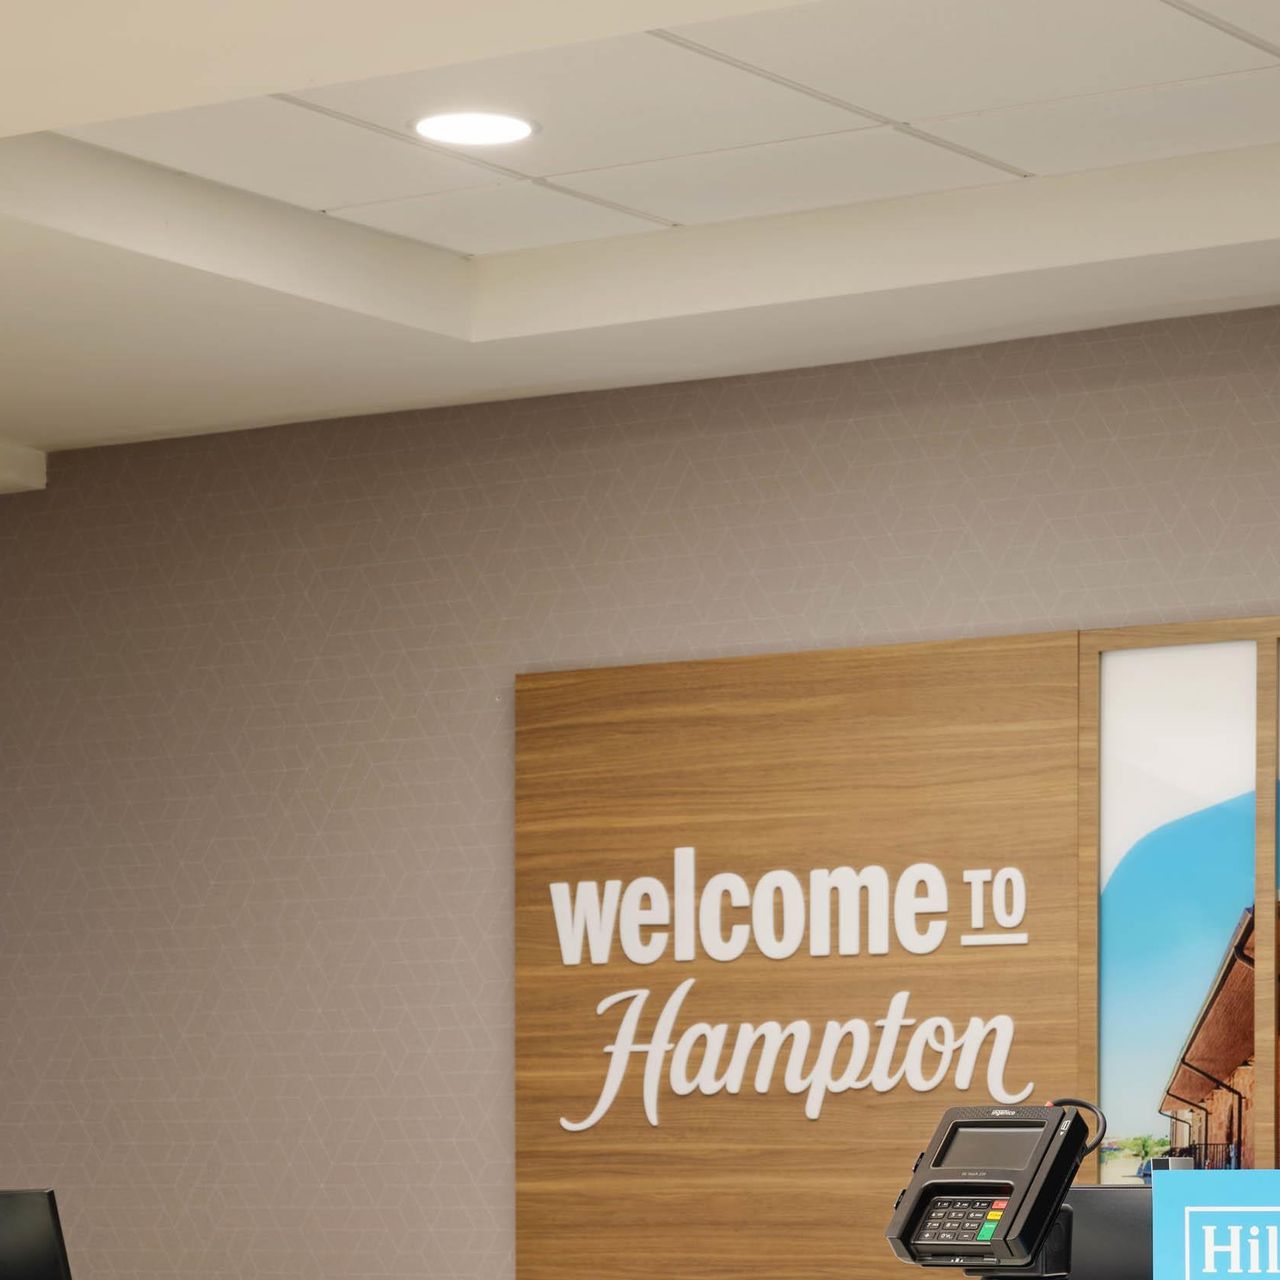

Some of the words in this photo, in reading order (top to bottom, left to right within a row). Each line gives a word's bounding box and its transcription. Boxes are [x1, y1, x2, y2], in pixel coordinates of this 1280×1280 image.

[549, 846, 949, 966] welcome
[962, 866, 1027, 929] TO
[559, 977, 1035, 1132] Hampton
